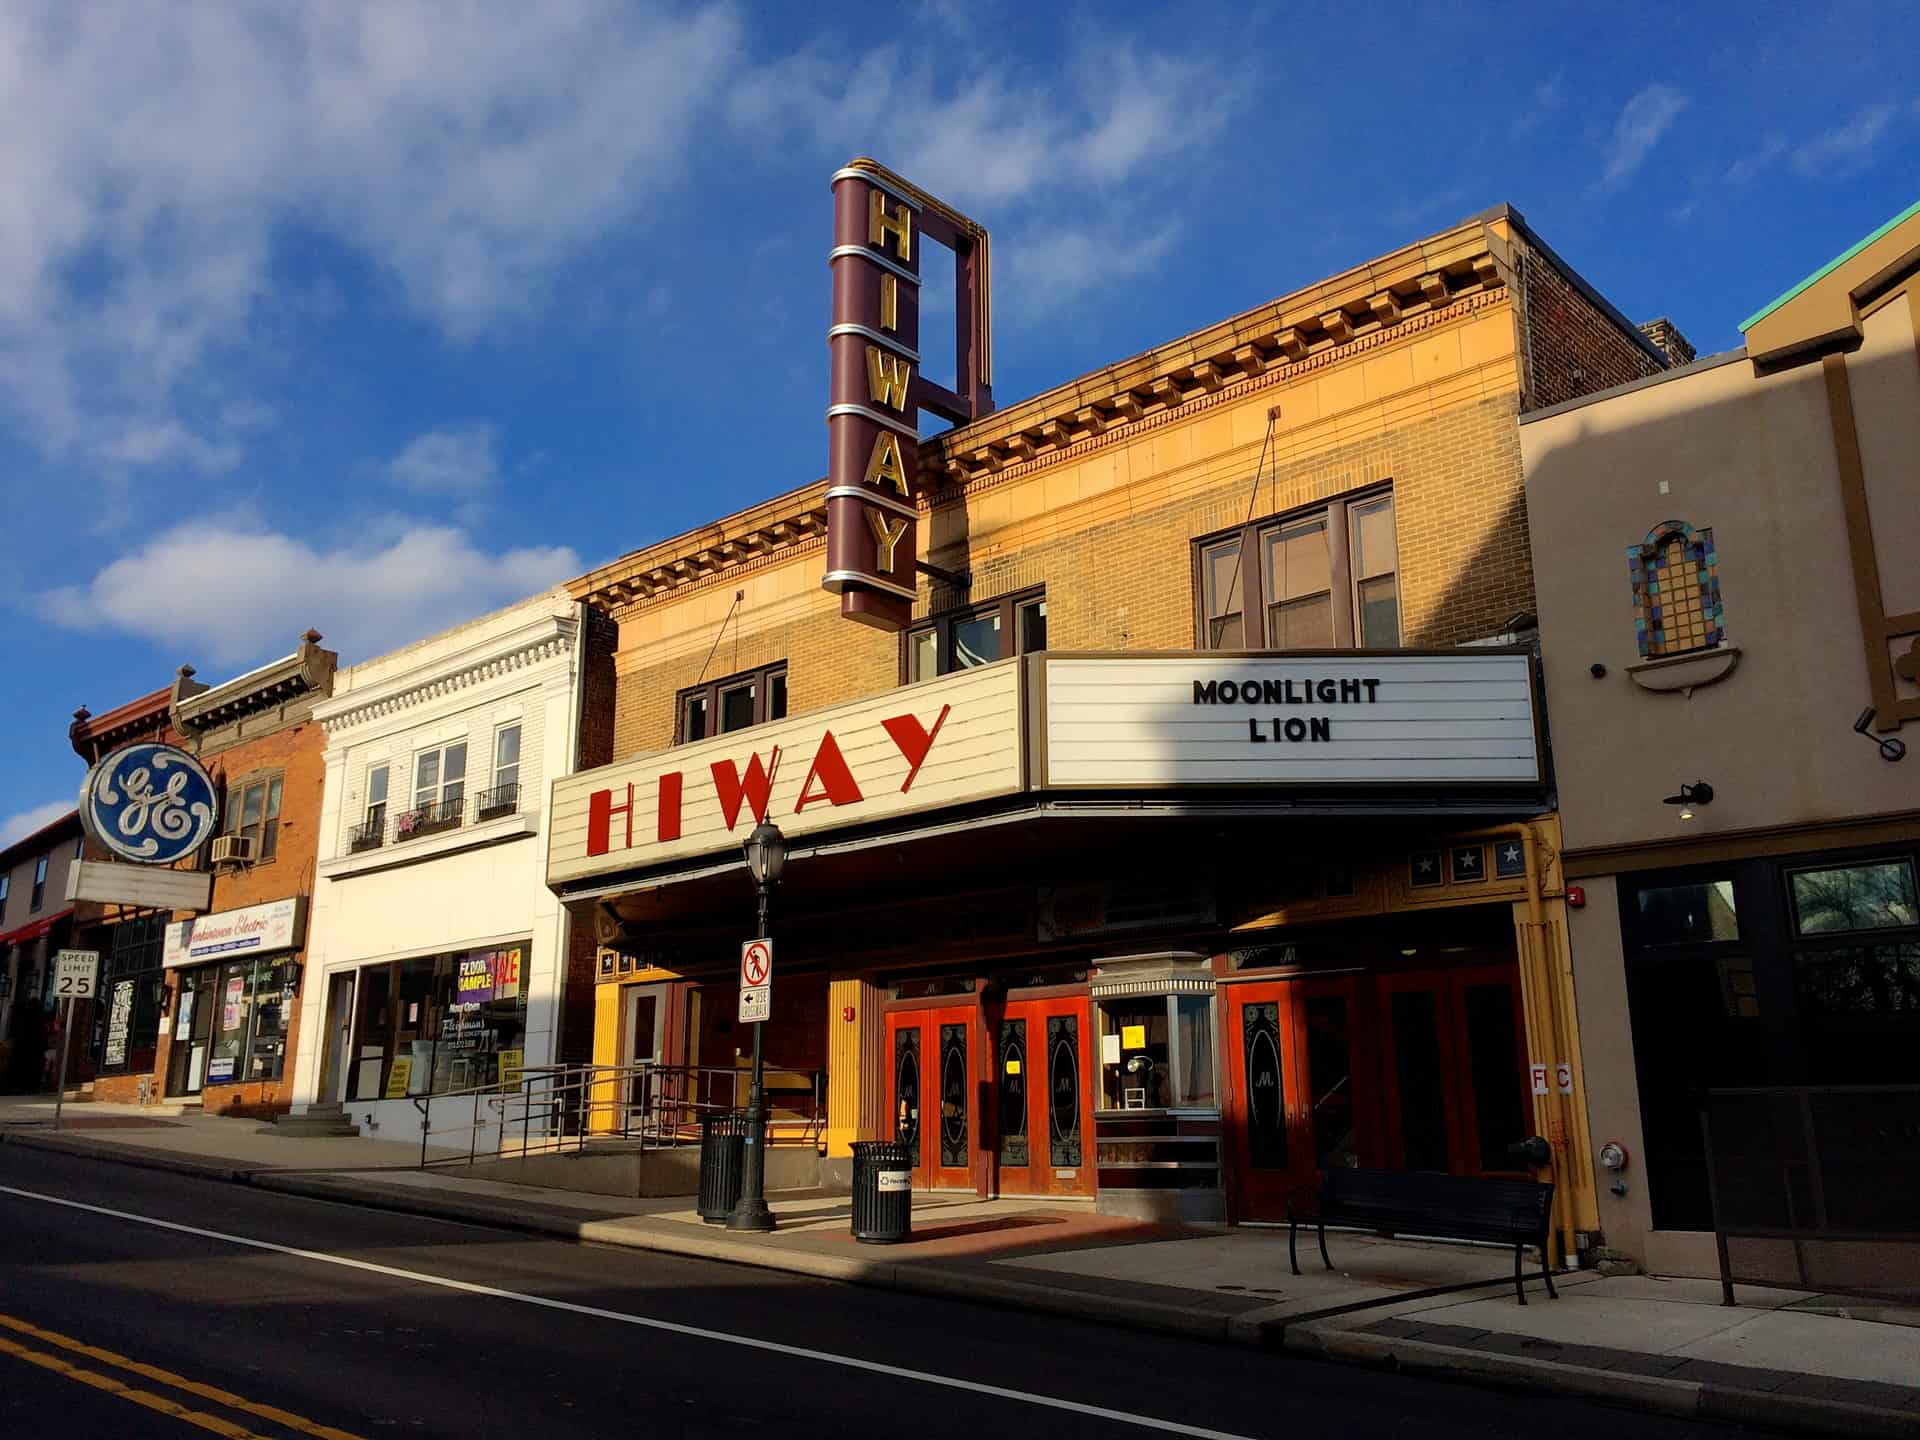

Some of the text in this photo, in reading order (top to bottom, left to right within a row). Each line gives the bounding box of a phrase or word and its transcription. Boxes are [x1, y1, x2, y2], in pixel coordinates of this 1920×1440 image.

[864, 187, 911, 575] HIWAY
[1193, 679, 1380, 705] MOONLIGHT
[1250, 717, 1330, 743] LION
[587, 703, 951, 857] HIWAY
[62, 953, 95, 962] SPEED
[63, 964, 91, 973] LIMIT
[59, 977, 89, 994] 25
